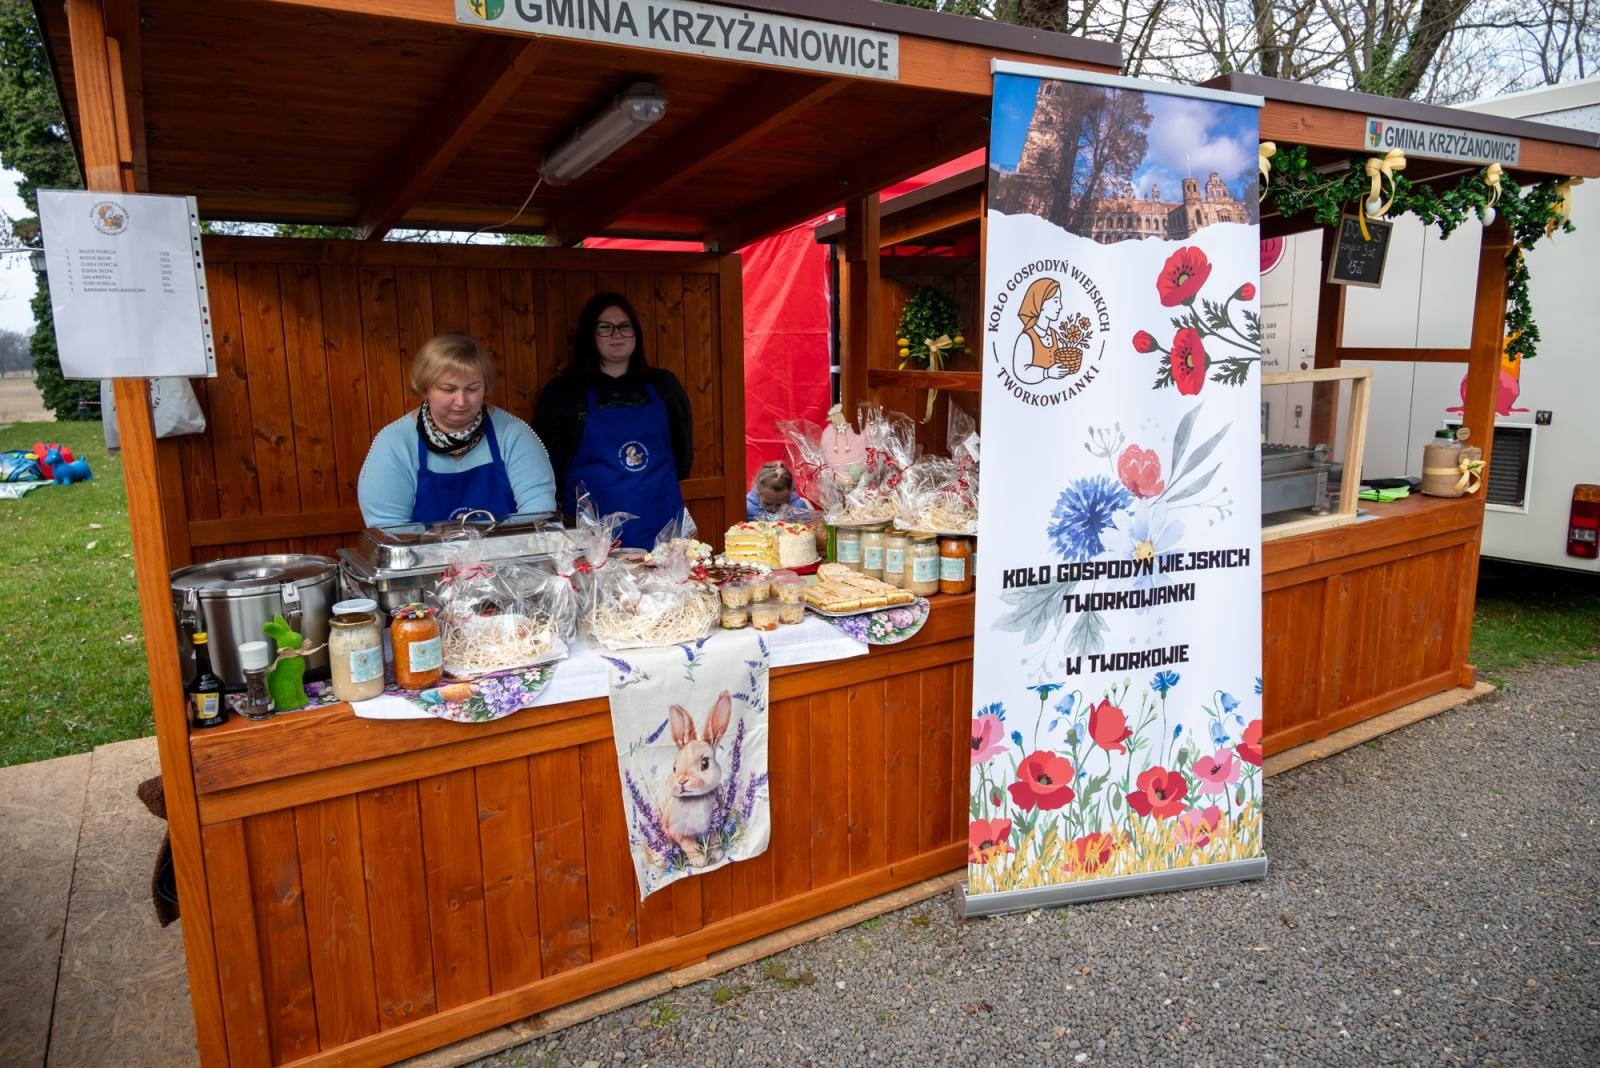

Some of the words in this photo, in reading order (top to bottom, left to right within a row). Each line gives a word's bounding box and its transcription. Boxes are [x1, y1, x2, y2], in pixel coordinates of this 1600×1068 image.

[515, 0, 639, 37] GMINA
[648, 5, 889, 72] KRZYŻANOWICE
[1384, 126, 1425, 151] GMINA
[1428, 131, 1517, 162] KRZYŻANOWICE
[988, 292, 1009, 333] KOŁO
[1006, 259, 1069, 292] GOSPODYŃ
[1070, 265, 1110, 333] WIEJSKICH
[996, 364, 1100, 407] TWORKOWIANKI
[1003, 565, 1051, 589] KOŁO
[1056, 551, 1154, 583] GOSPODYŃ
[1158, 548, 1251, 574] WIEJSKICH
[1063, 583, 1196, 614] TWORKOWIANKI
[1066, 656, 1081, 676] W
[1088, 644, 1189, 673] TWORKOWIE
